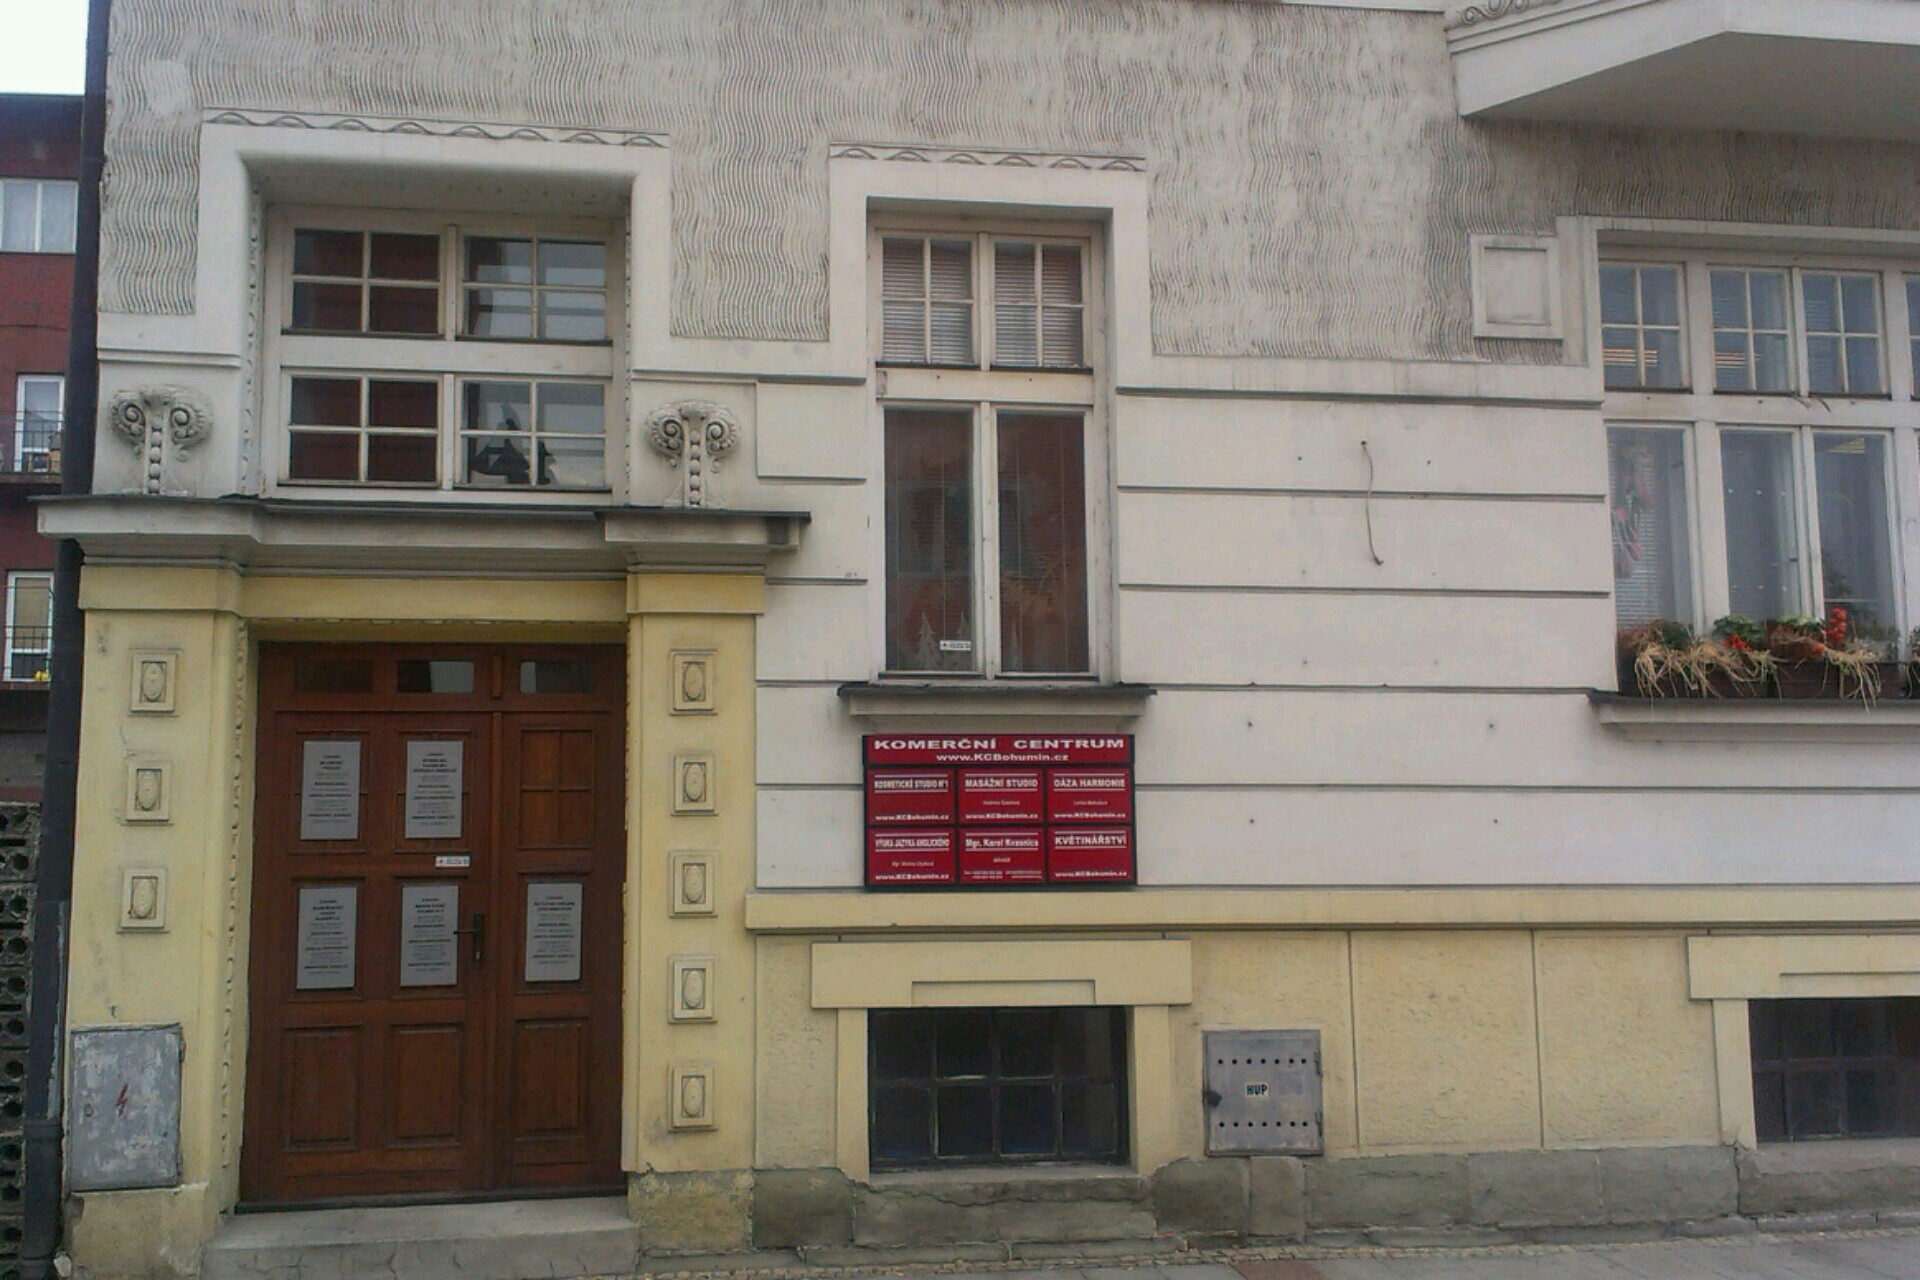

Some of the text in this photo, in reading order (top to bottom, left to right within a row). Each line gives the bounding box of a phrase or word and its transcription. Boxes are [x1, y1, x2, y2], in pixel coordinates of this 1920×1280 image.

[874, 738, 1124, 749] KOMERČNÍ CENTRUM
[936, 753, 1069, 761] www.KCBohumin.cz
[965, 778, 1038, 788] MASÁŽNÍ STUDIO
[1053, 777, 1126, 788] OÁZA HARMONIE
[1055, 834, 1127, 846] KVĚTINÁŘSTVÍ
[1246, 1084, 1268, 1096] HUP
